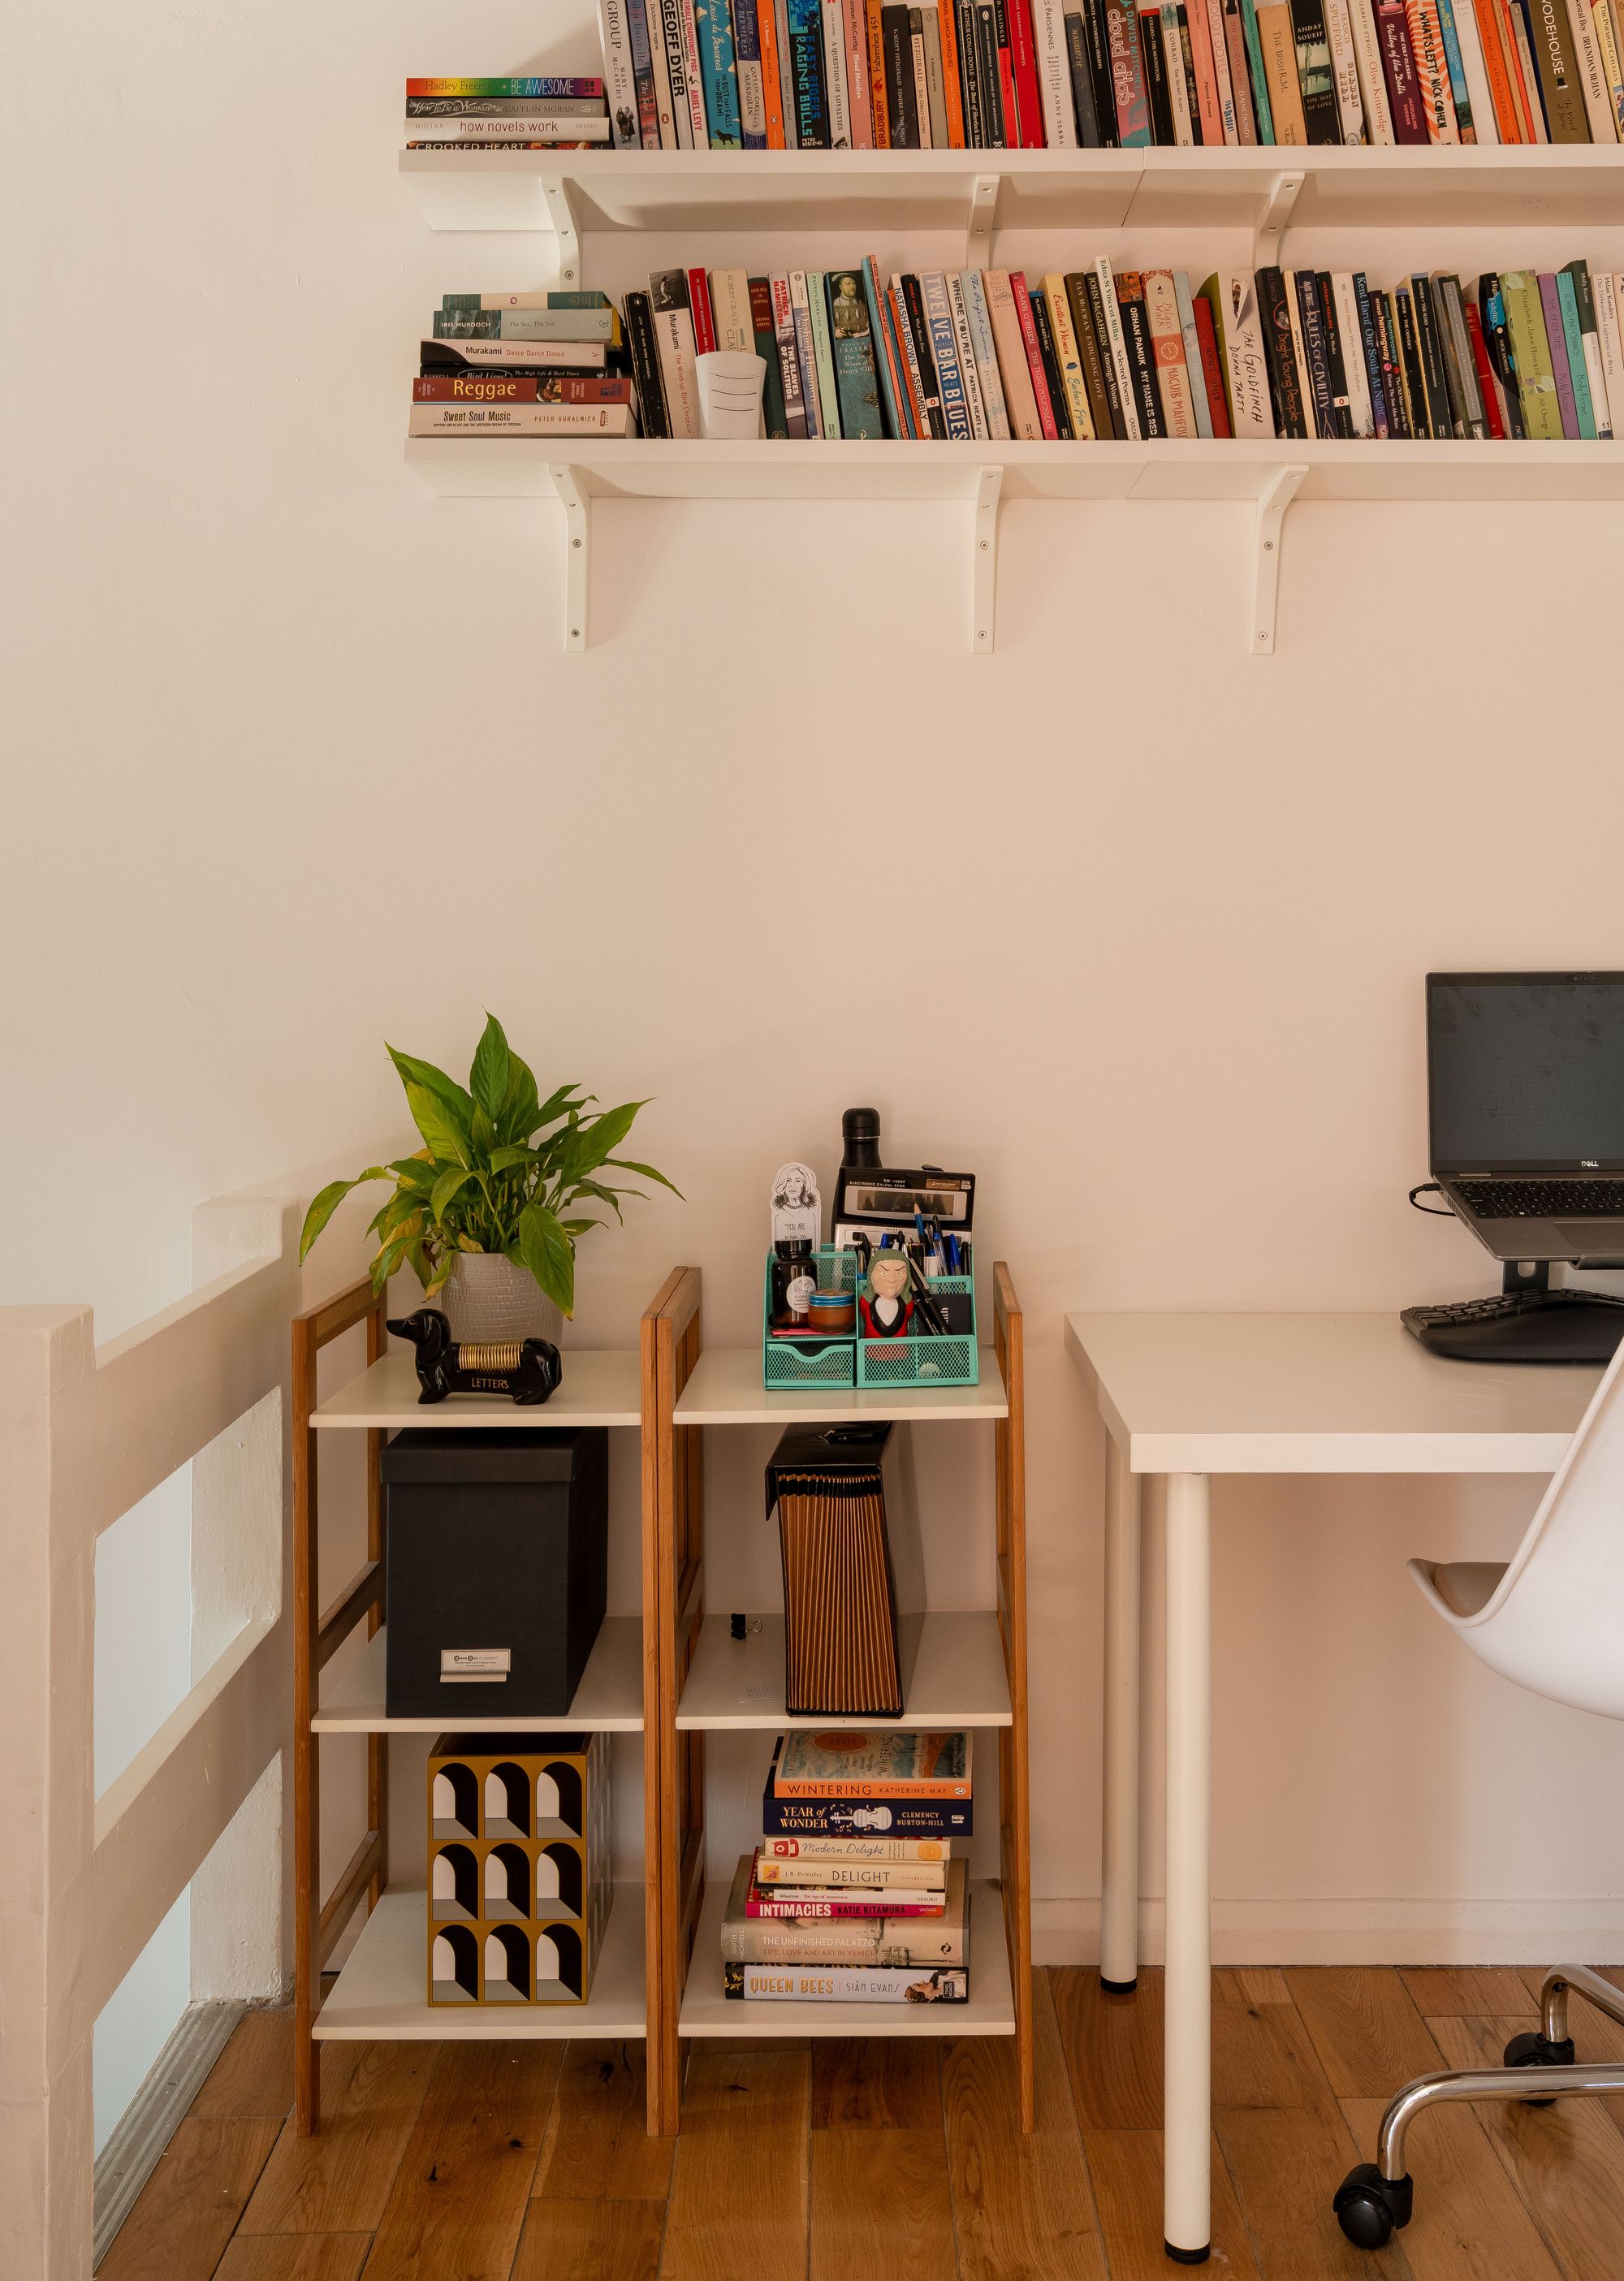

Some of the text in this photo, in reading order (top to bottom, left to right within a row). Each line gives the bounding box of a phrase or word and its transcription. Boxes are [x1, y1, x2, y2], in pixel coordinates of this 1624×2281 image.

[607, 1, 621, 49] GROUP
[663, 0, 679, 49] GEOFF
[1126, 11, 1136, 42] DAVID
[670, 55, 685, 97] DYER
[831, 48, 840, 81] QUESTION
[914, 37, 922, 81] FITZGERALD
[1108, 9, 1135, 106] cloud atlas
[1272, 31, 1289, 93] THE IRISH R.M.
[1386, 24, 1396, 49] Valley
[1394, 74, 1406, 94] Dolls
[1419, 12, 1447, 129] WHAT'S LEFT? NICK COHEN
[1583, 36, 1601, 99] BRENDAN BEHAN
[425, 81, 499, 92] Hadley Freeman
[511, 79, 573, 94] BE AWESOME
[612, 57, 622, 100] McCARTHY
[744, 73, 752, 115] MANDOLIN
[750, 67, 758, 93] CAPTAIN
[796, 37, 812, 136] RAGING BULLS
[806, 36, 821, 119] EASY RIDERS
[835, 84, 840, 93] OF
[690, 90, 702, 131] ARIEL LEVY
[1369, 62, 1387, 134] Olive Kitteridge
[460, 122, 559, 132] how novels work
[773, 281, 784, 325] HAMILTON
[780, 280, 789, 317] PATRICK
[668, 313, 680, 350] Murakami
[1241, 330, 1255, 349] The
[1357, 277, 1385, 417] Kent Haruf Our Souls At Night
[1521, 289, 1541, 376] Elizabeth Jane Howard
[894, 287, 927, 420] NATASHA BROWN ASSEMBLY
[926, 275, 968, 440] TWELVE BAR BLUES
[1017, 284, 1052, 430] FLANN O'BRIEN THE THIRD POLICEMAN
[1130, 307, 1158, 435] ORHAN PAMUK MY NAME IS RED
[453, 380, 516, 400] Reggae
[676, 366, 686, 391] Wind-up
[780, 346, 793, 400] OF SOLITUDE
[789, 364, 799, 395] SLAVES
[1229, 346, 1245, 414] DONNA TARTT
[443, 411, 511, 421] Sweet Soul Music
[680, 392, 689, 405] Bird
[684, 407, 693, 434] Chronicle
[472, 1378, 509, 1389] LETTERS
[788, 1785, 872, 1795] WINTERING
[780, 1818, 828, 1829] WONDER
[783, 1806, 827, 1817] YEAR of
[802, 1843, 843, 1853] Modern
[845, 1843, 884, 1855] Delight
[832, 1871, 890, 1883] DELIGHT
[760, 1903, 905, 1916] INTIMACIES KATIE KITAMURA
[762, 1937, 875, 1947] THE UNFINISHED PALAZZO
[763, 1949, 781, 1957] LIFE,
[750, 1977, 834, 1994] QUEEN BEES
